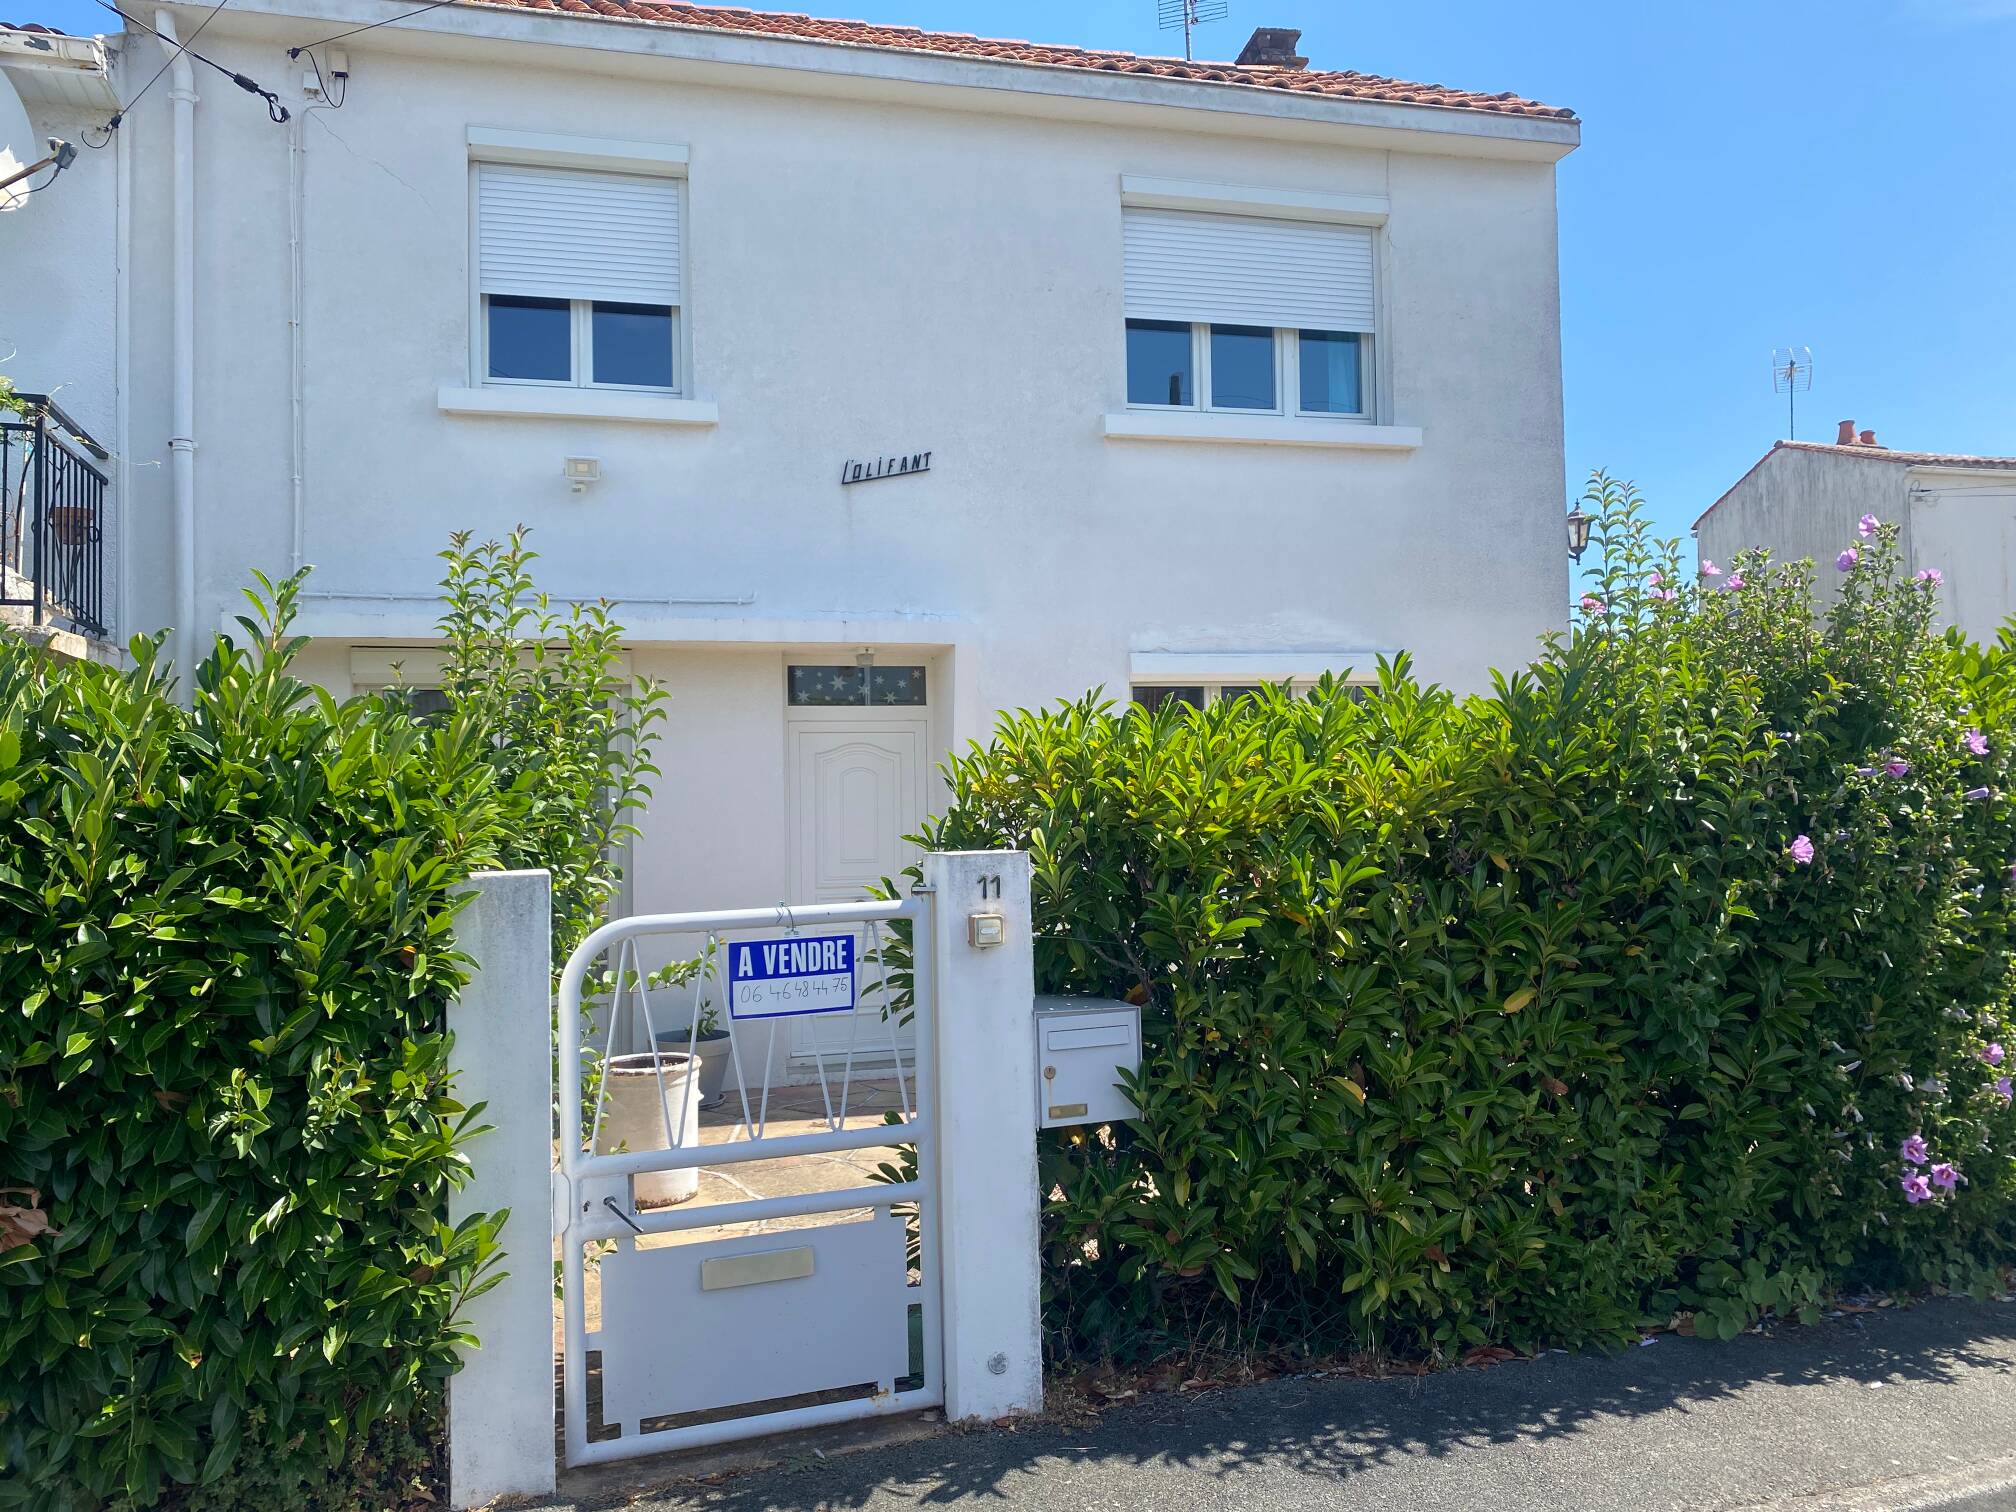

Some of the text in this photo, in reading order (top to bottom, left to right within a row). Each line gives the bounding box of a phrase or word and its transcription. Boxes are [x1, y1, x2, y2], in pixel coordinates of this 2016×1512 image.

[976, 874, 1001, 899] 11
[738, 939, 848, 977] A VENDRE
[740, 976, 849, 1004] 06 46 48 44 75
